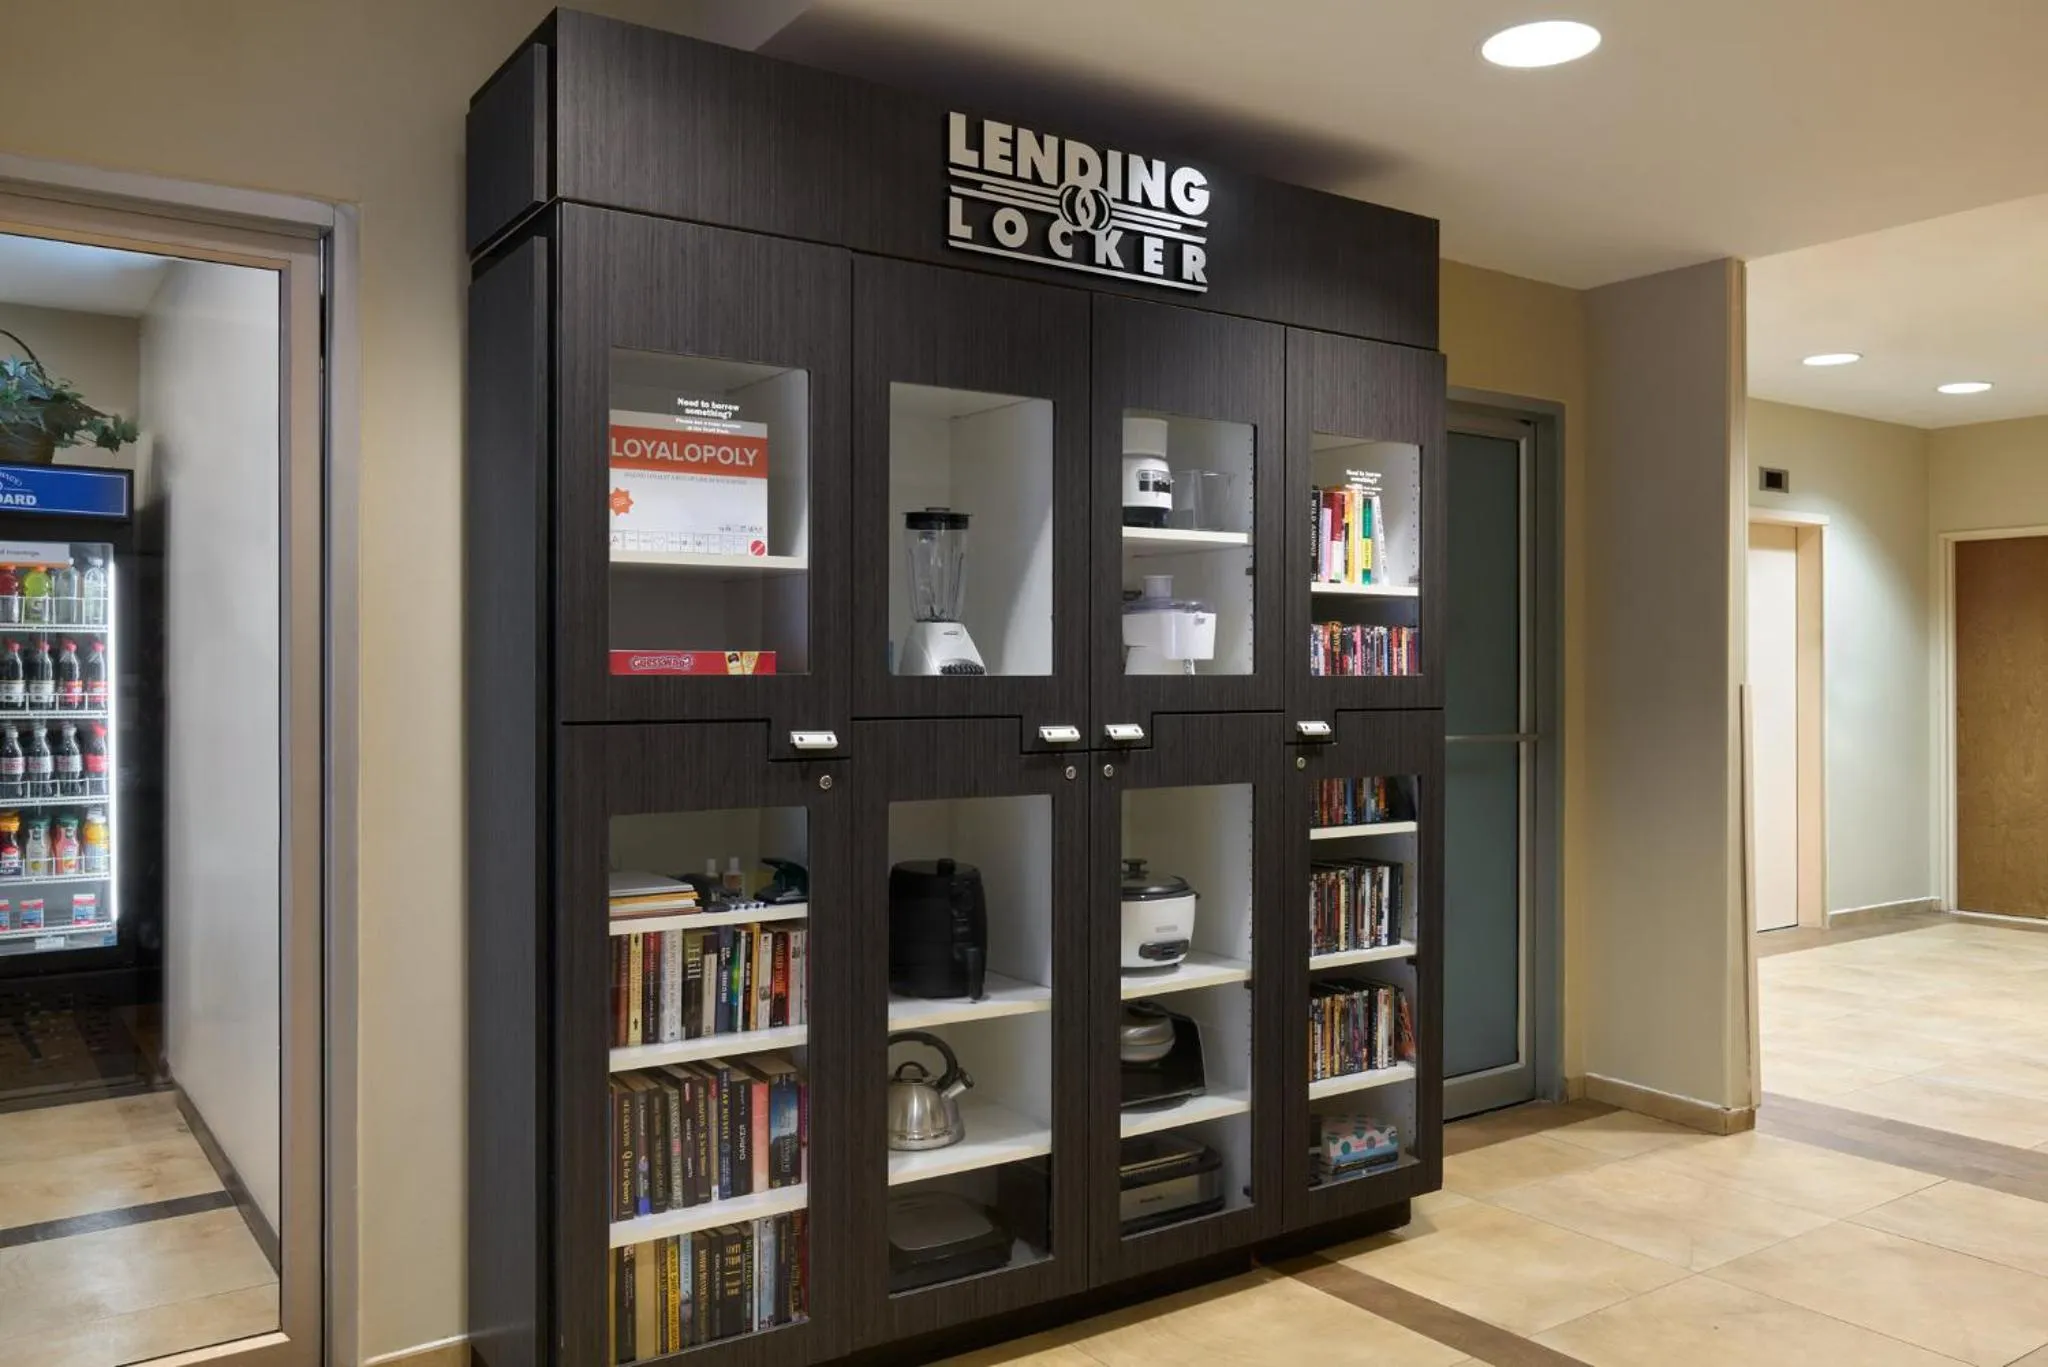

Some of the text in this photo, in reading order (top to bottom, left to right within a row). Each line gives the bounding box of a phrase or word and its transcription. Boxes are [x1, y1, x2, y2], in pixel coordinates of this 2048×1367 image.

[949, 111, 1210, 217] LENDING
[949, 195, 1209, 284] LOCKER
[677, 397, 740, 411] Need to borrow
[685, 407, 732, 419] something?
[611, 437, 759, 467] LOYALOPOLY
[687, 945, 702, 980] Hill
